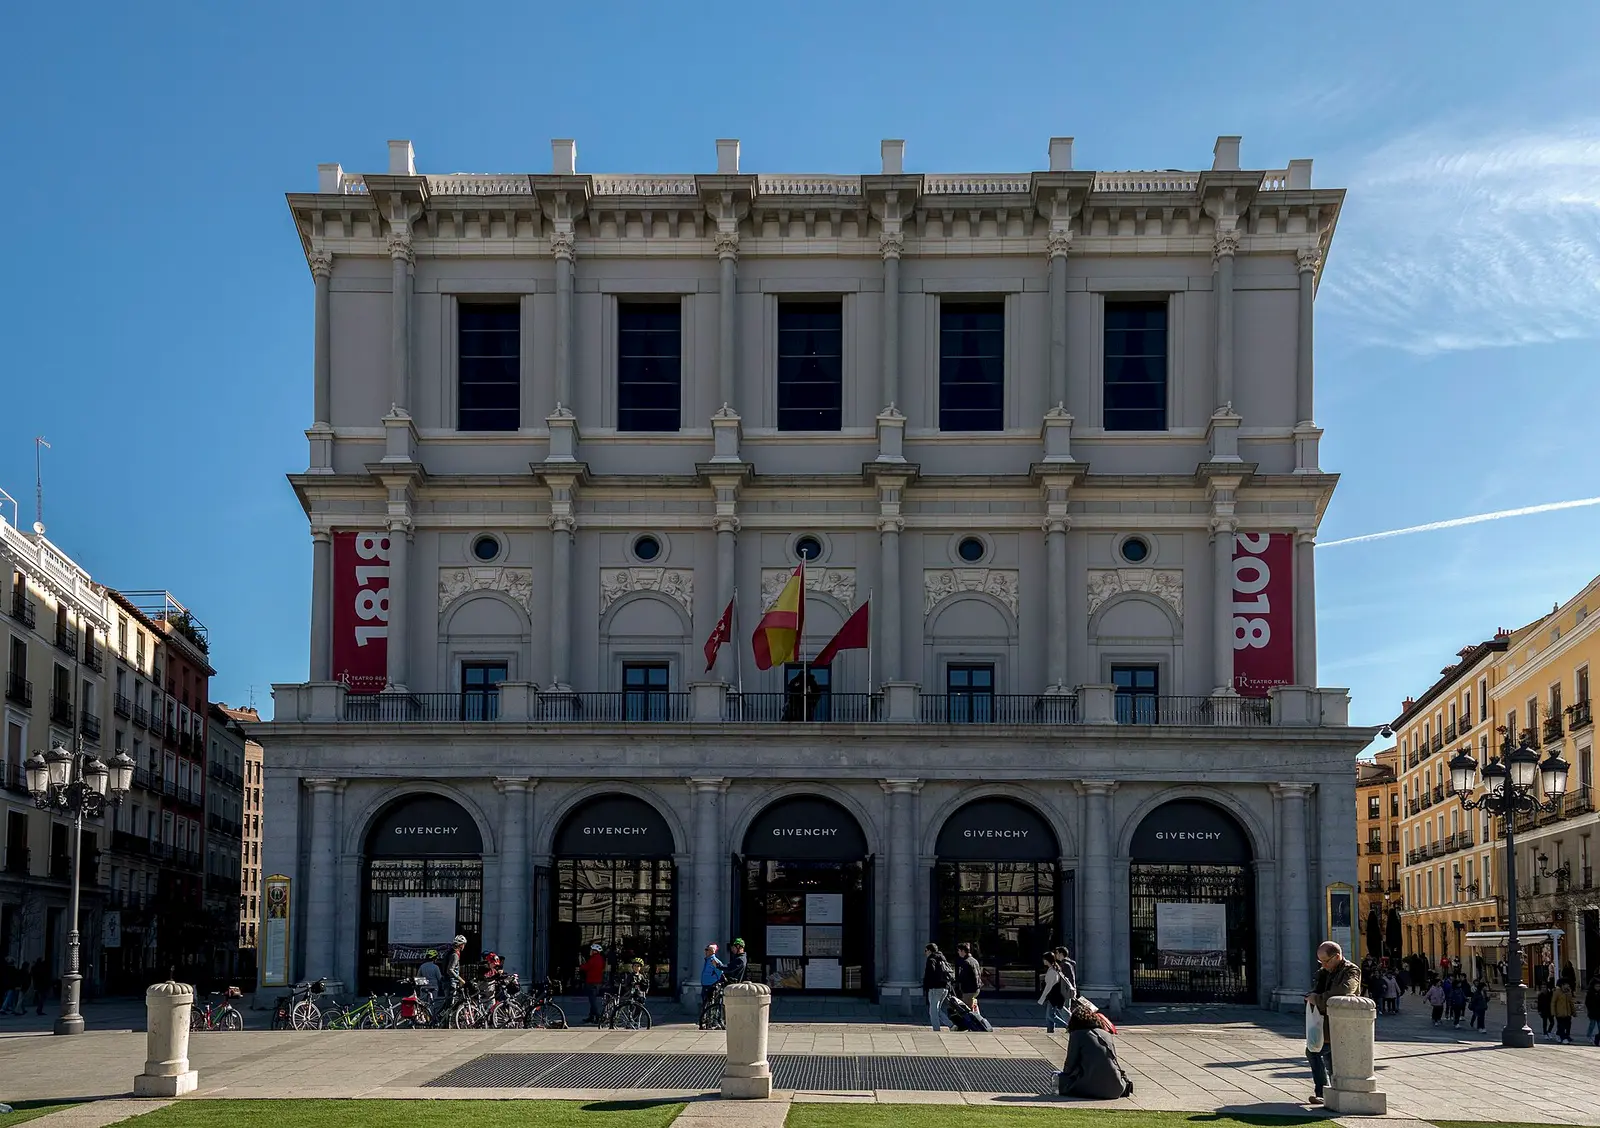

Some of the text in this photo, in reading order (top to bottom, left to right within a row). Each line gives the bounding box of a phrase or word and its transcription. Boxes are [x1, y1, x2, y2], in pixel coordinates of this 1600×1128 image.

[354, 532, 390, 647] 1818
[1232, 533, 1270, 650] 2018
[394, 826, 458, 835] GIVENCHY
[583, 827, 648, 836] GIVENCHY
[772, 828, 838, 836] GIVENCHY
[963, 829, 1029, 838] GIVENCHY
[1155, 831, 1221, 840] GIVENCHY
[1163, 955, 1222, 967] Visit the Real
